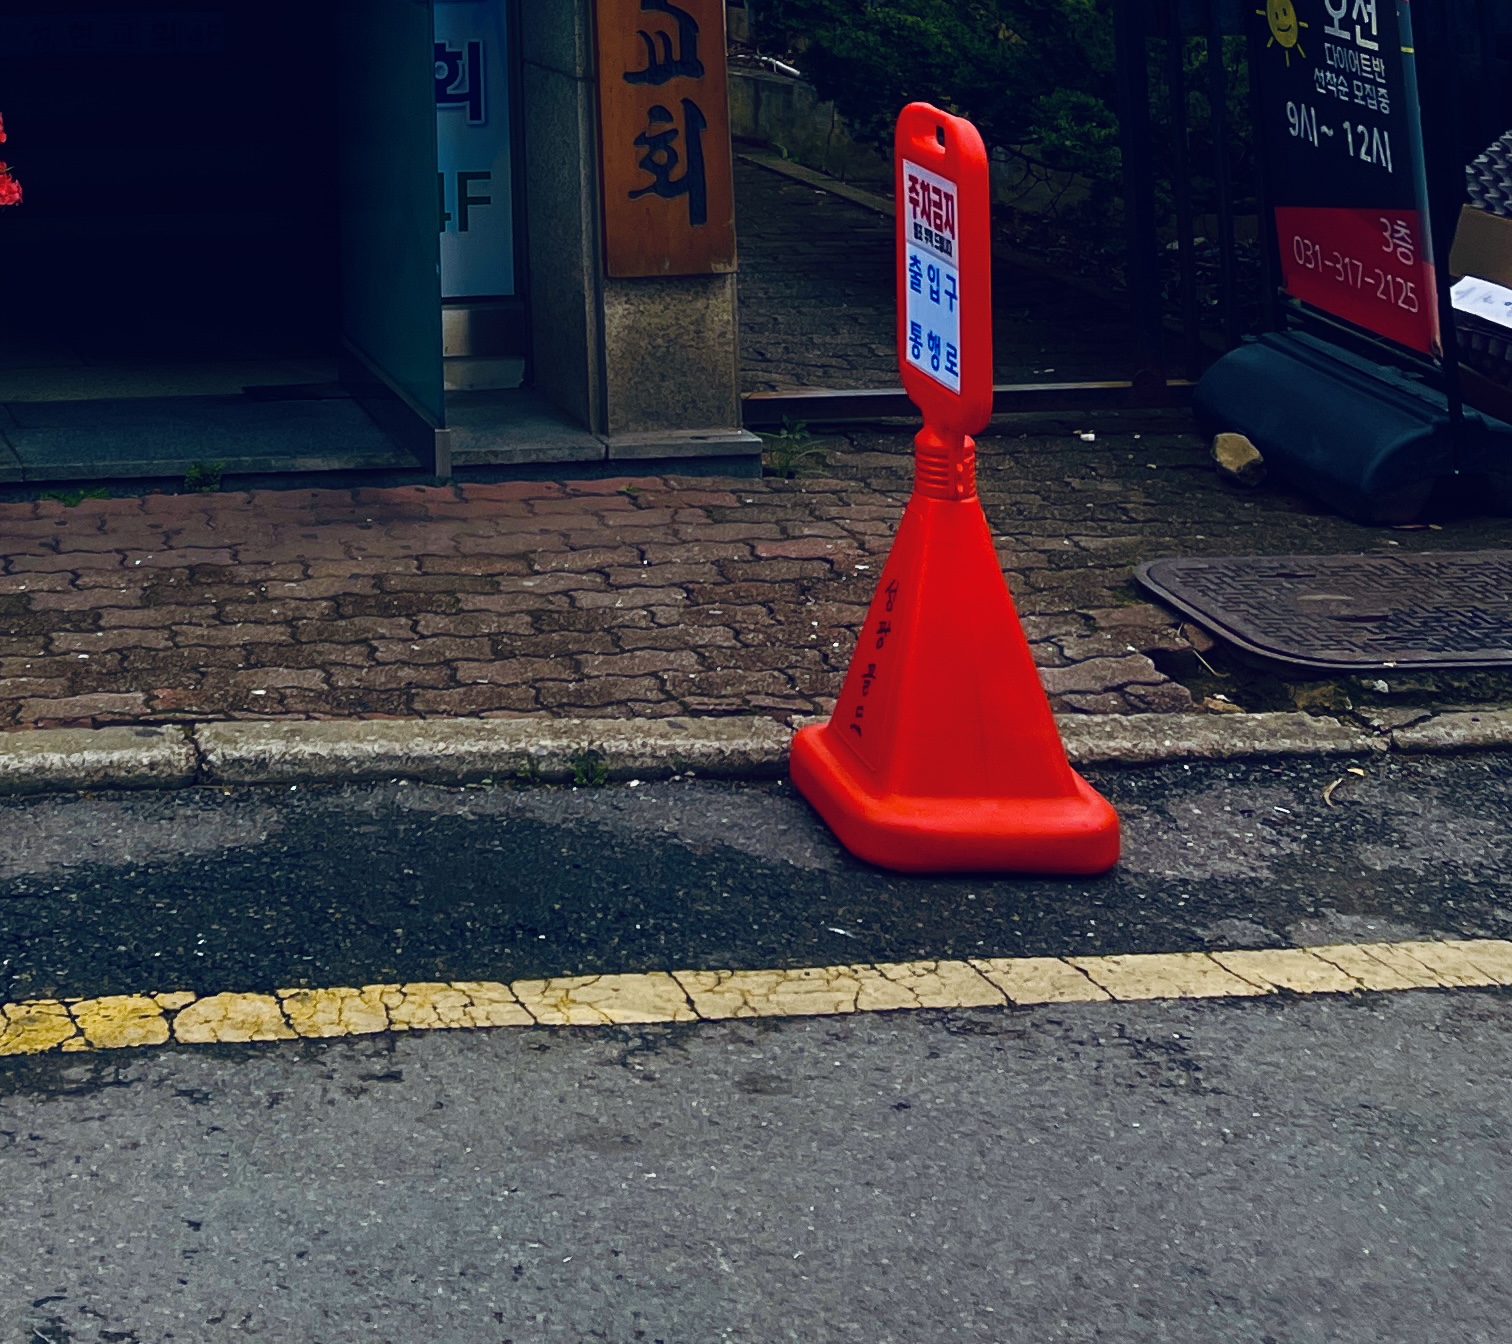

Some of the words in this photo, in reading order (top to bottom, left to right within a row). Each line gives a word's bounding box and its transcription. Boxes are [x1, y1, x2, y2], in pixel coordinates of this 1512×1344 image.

[1323, 42, 1387, 84] 다이어트반
[1352, 79, 1392, 115] 모집중
[908, 173, 956, 241] 주차금지
[1379, 217, 1415, 266] 3층
[909, 254, 959, 313] 출입구
[1293, 235, 1420, 313] 031-317-2125
[909, 320, 959, 378] 통행로
